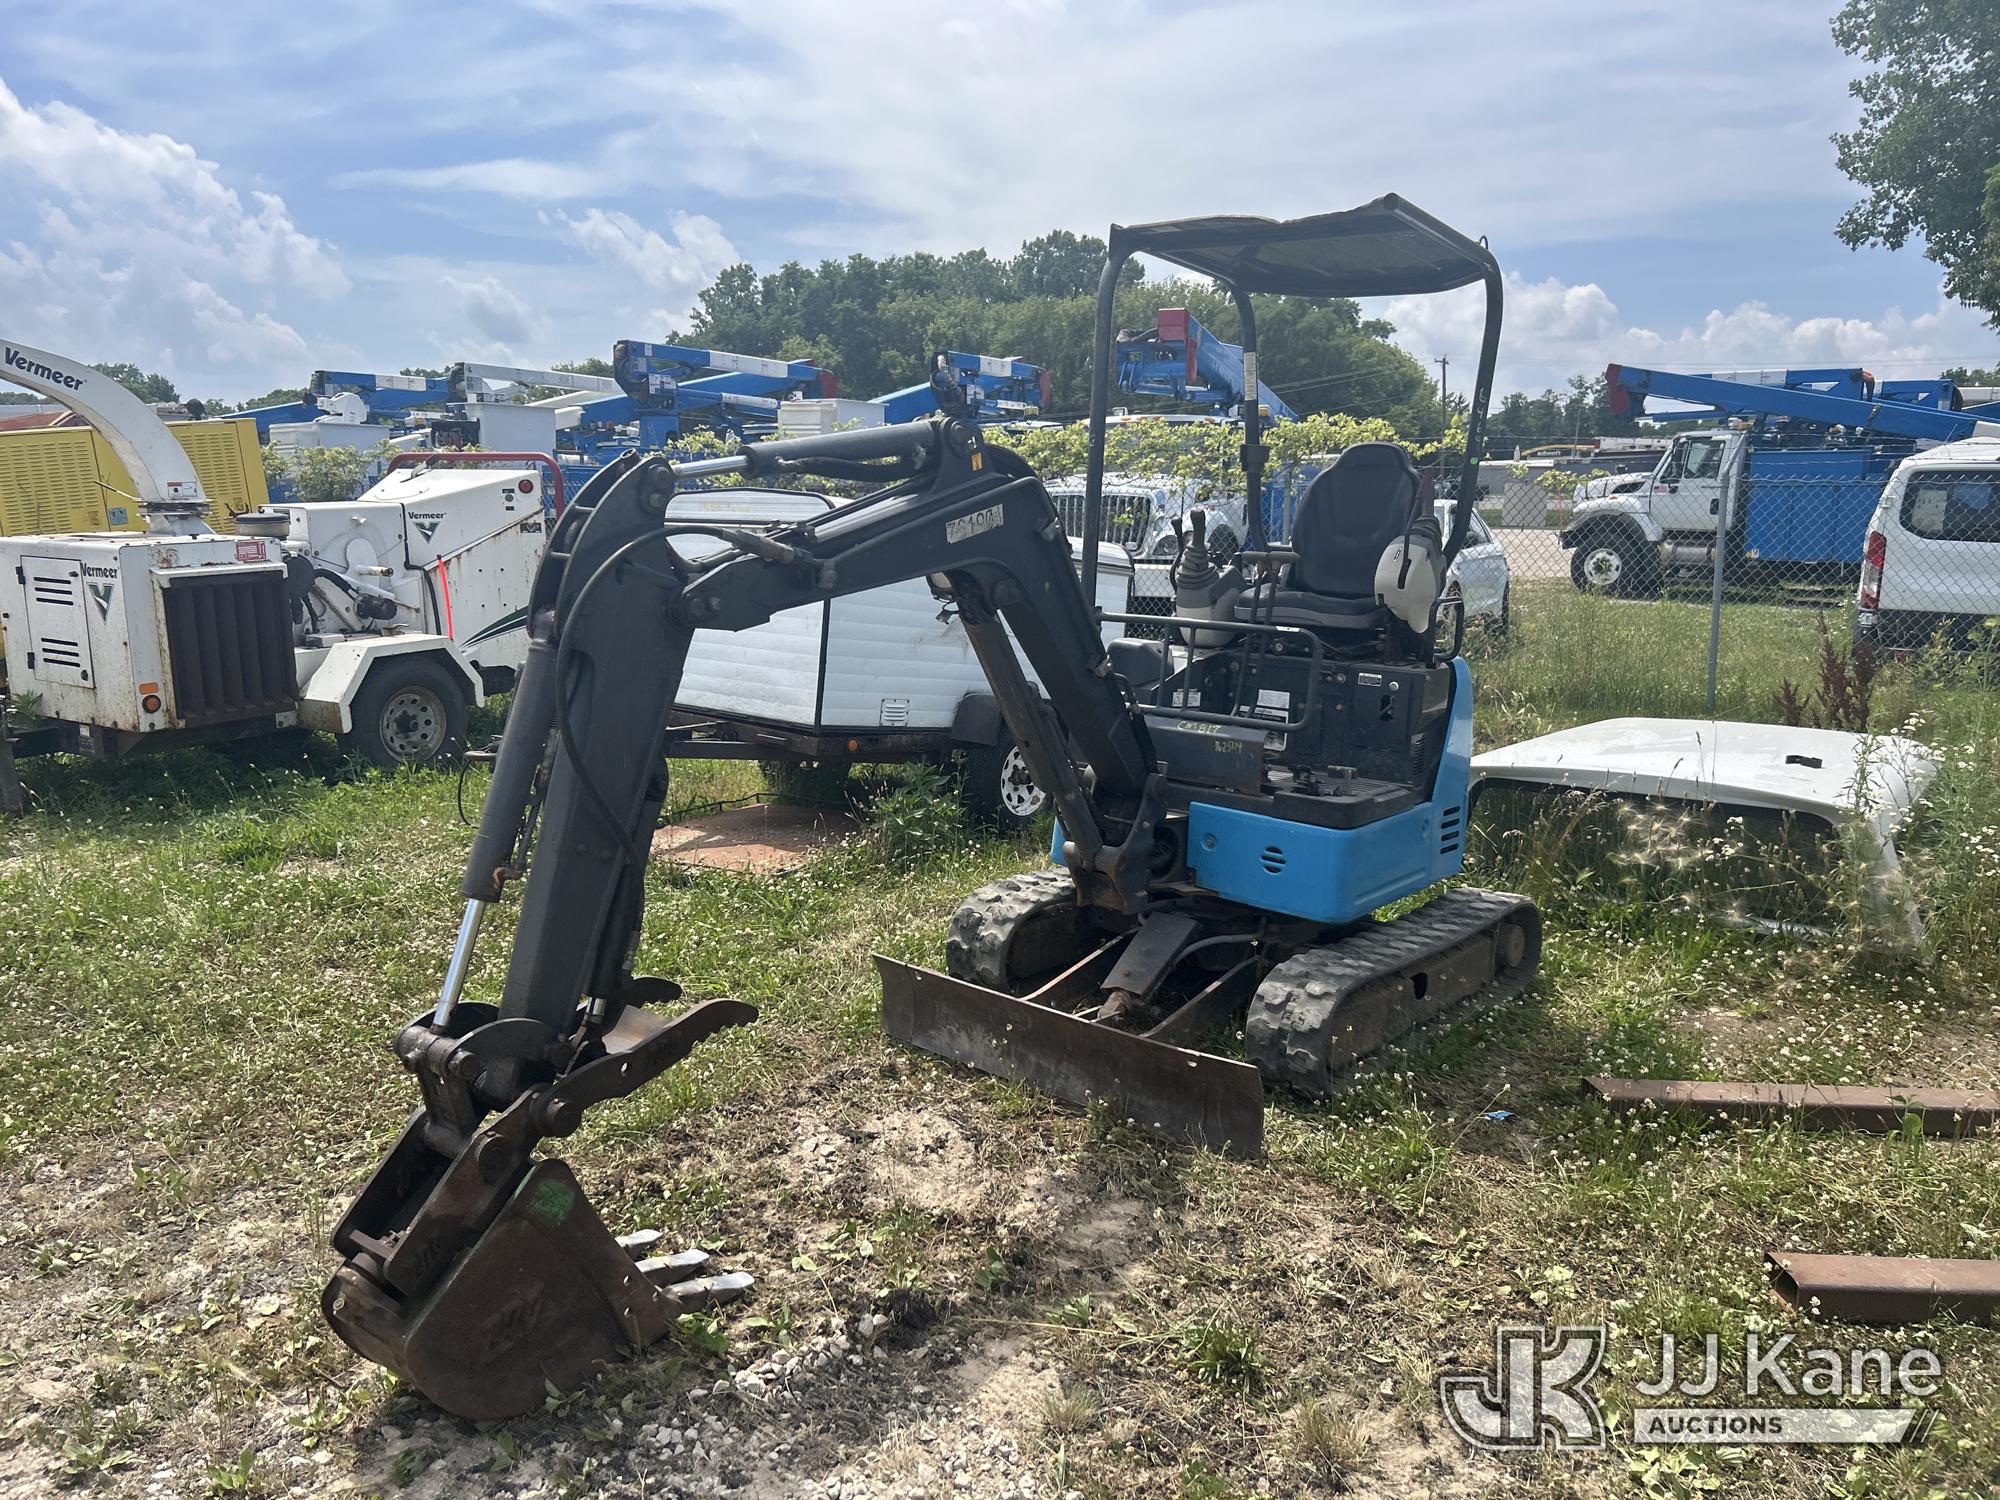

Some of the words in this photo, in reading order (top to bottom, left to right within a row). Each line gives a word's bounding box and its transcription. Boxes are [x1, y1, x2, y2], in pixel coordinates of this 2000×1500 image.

[5, 346, 83, 391] Vermeer
[408, 512, 445, 520] Vermeer
[80, 562, 118, 579] Vermeer
